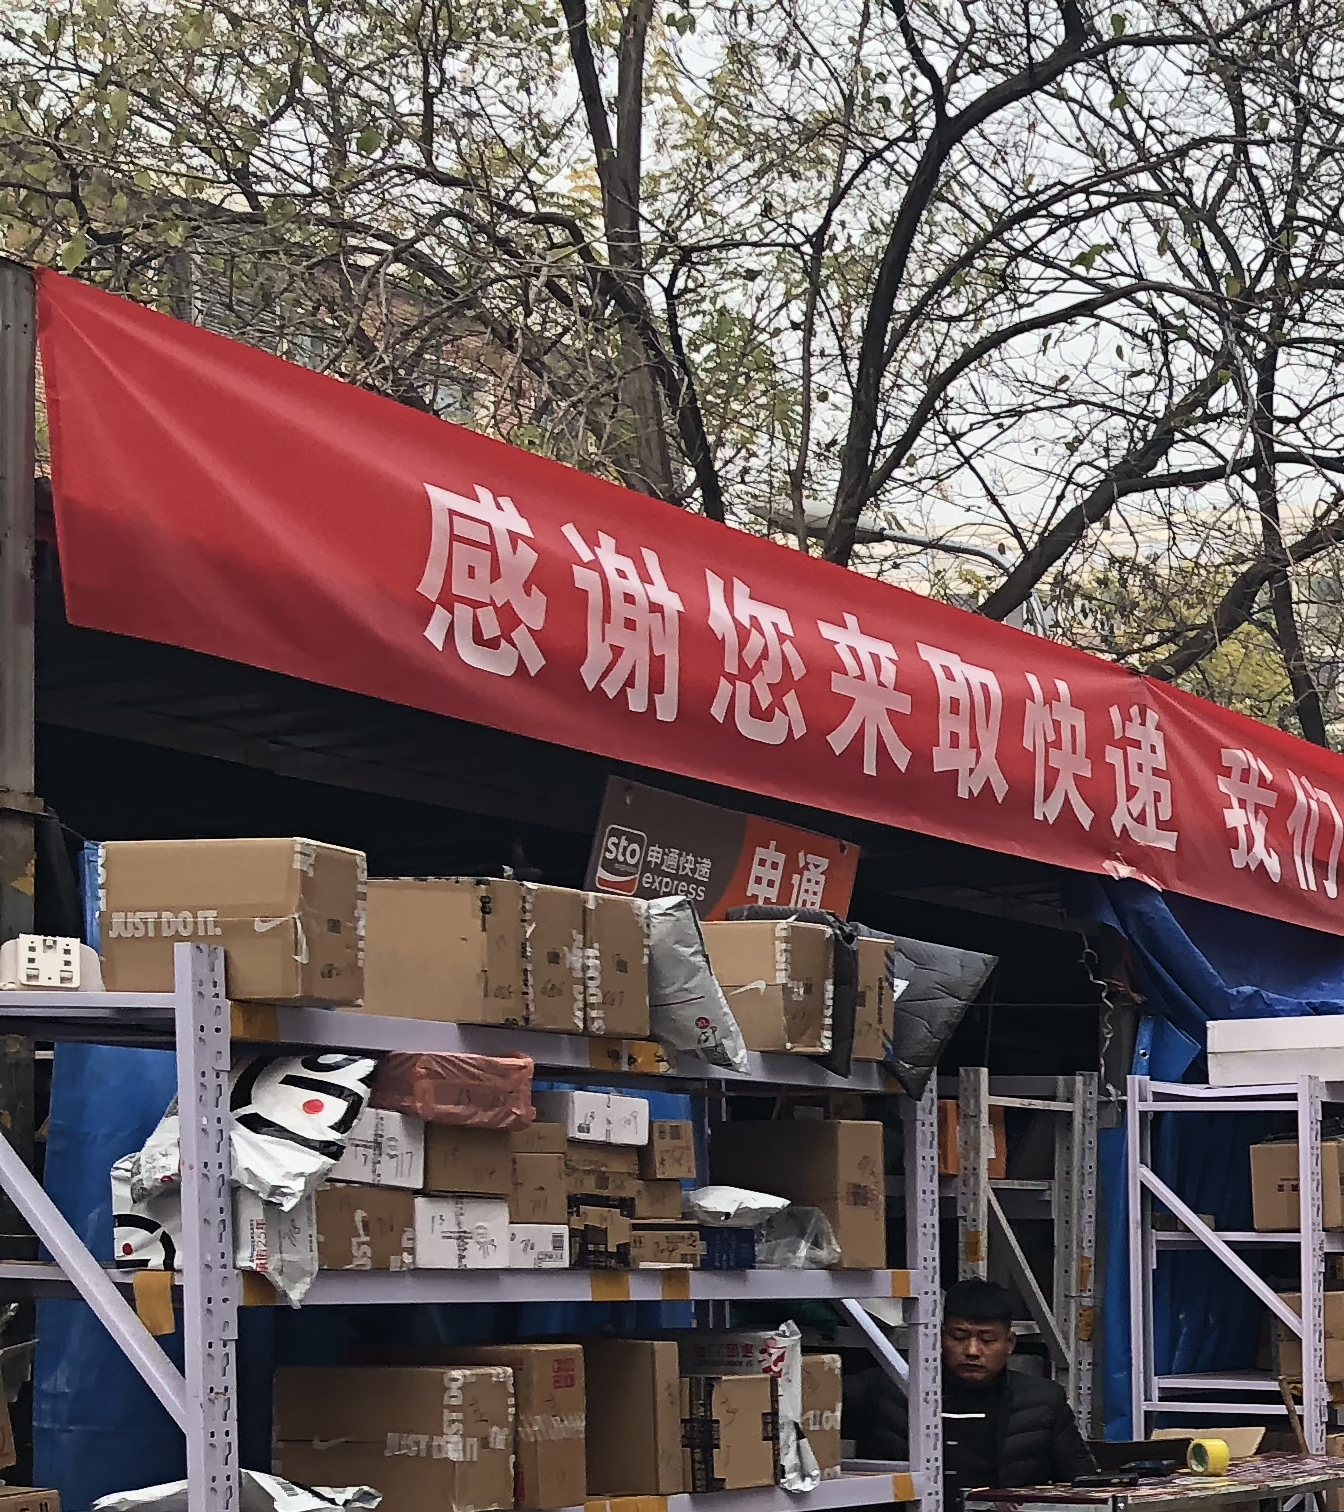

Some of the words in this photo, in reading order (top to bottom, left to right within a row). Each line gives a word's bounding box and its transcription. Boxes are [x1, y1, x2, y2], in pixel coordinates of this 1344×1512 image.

[416, 481, 1179, 851] 感谢您来取快递
[604, 835, 640, 865] sto
[646, 843, 712, 883] 申通快递
[642, 872, 706, 901] express
[746, 840, 829, 908] 申通
[109, 913, 158, 938] JUST
[161, 912, 194, 938] DO
